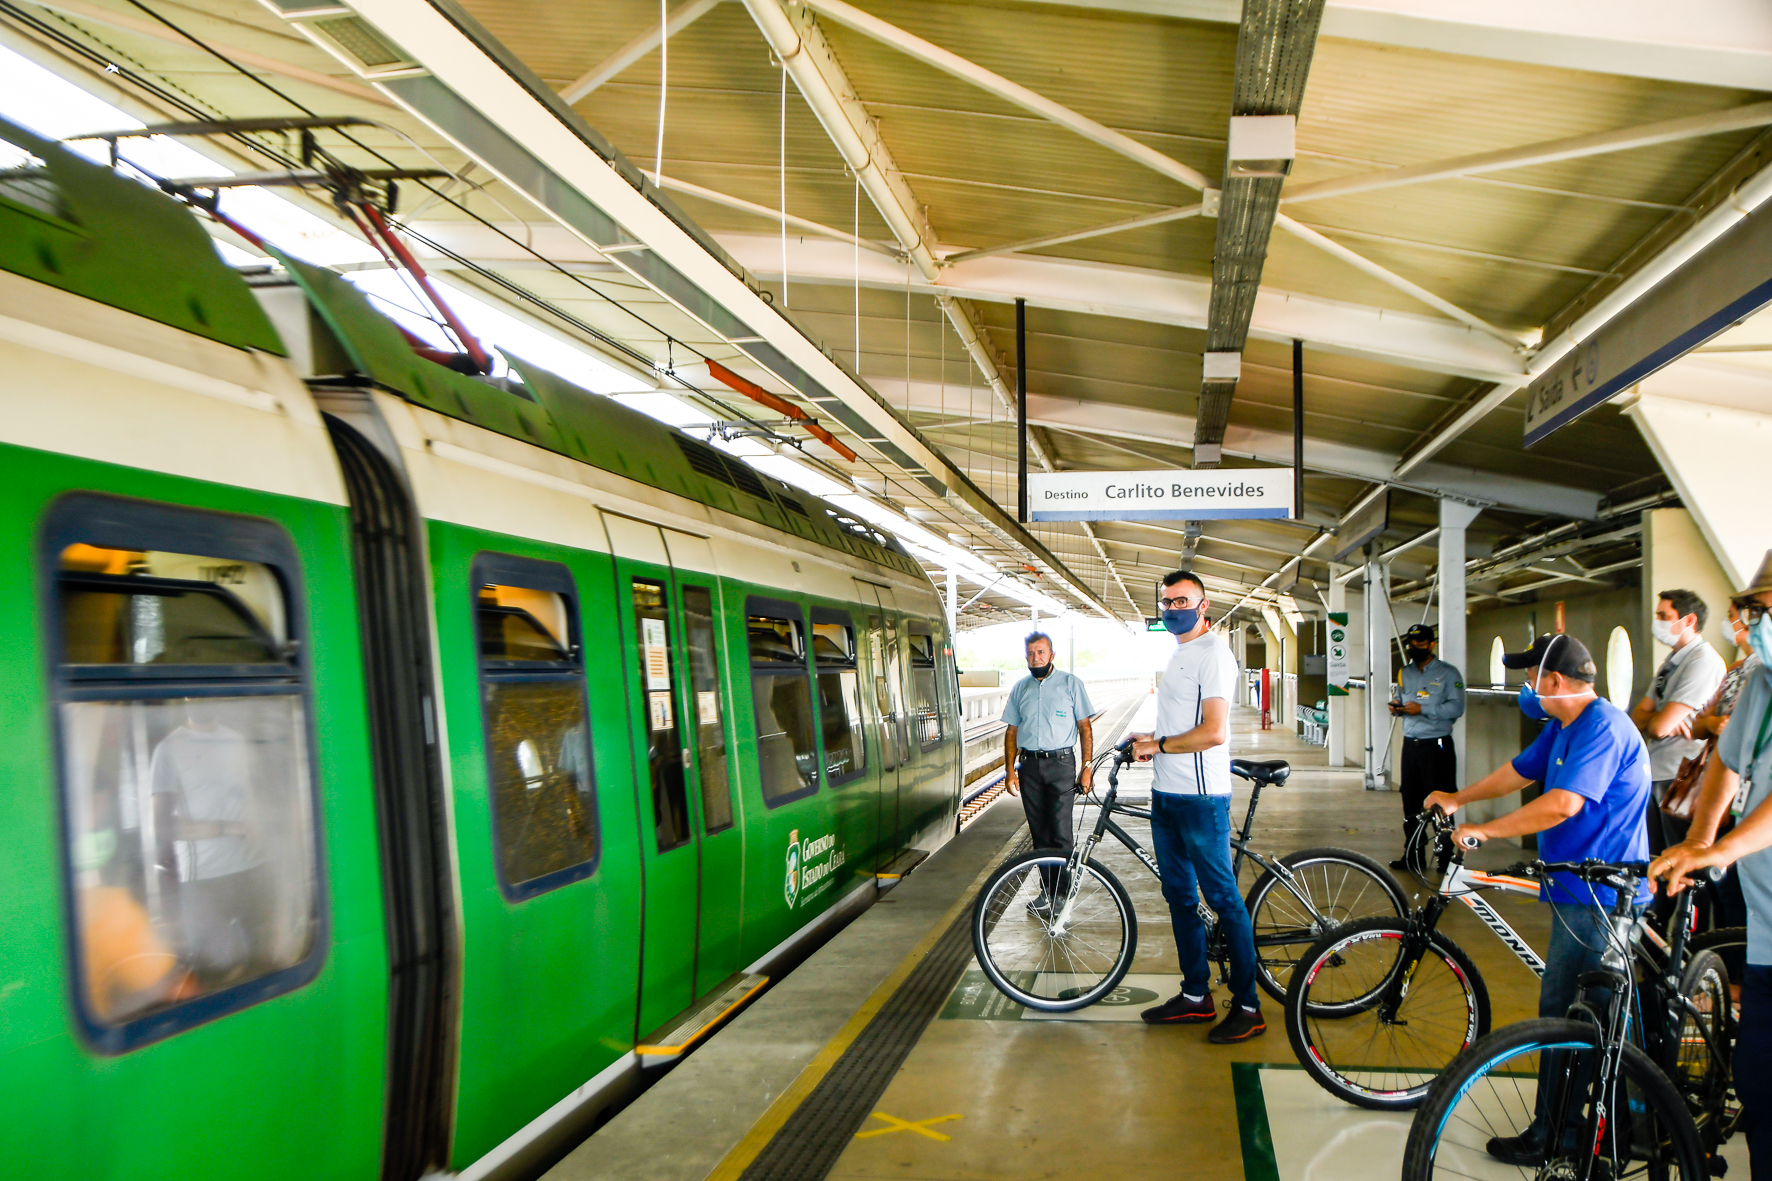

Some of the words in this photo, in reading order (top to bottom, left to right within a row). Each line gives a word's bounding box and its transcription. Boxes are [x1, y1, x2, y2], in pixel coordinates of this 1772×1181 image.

[1044, 489, 1089, 500] Destino
[1105, 484, 1165, 499] Carlito
[1171, 482, 1265, 498] Benevides
